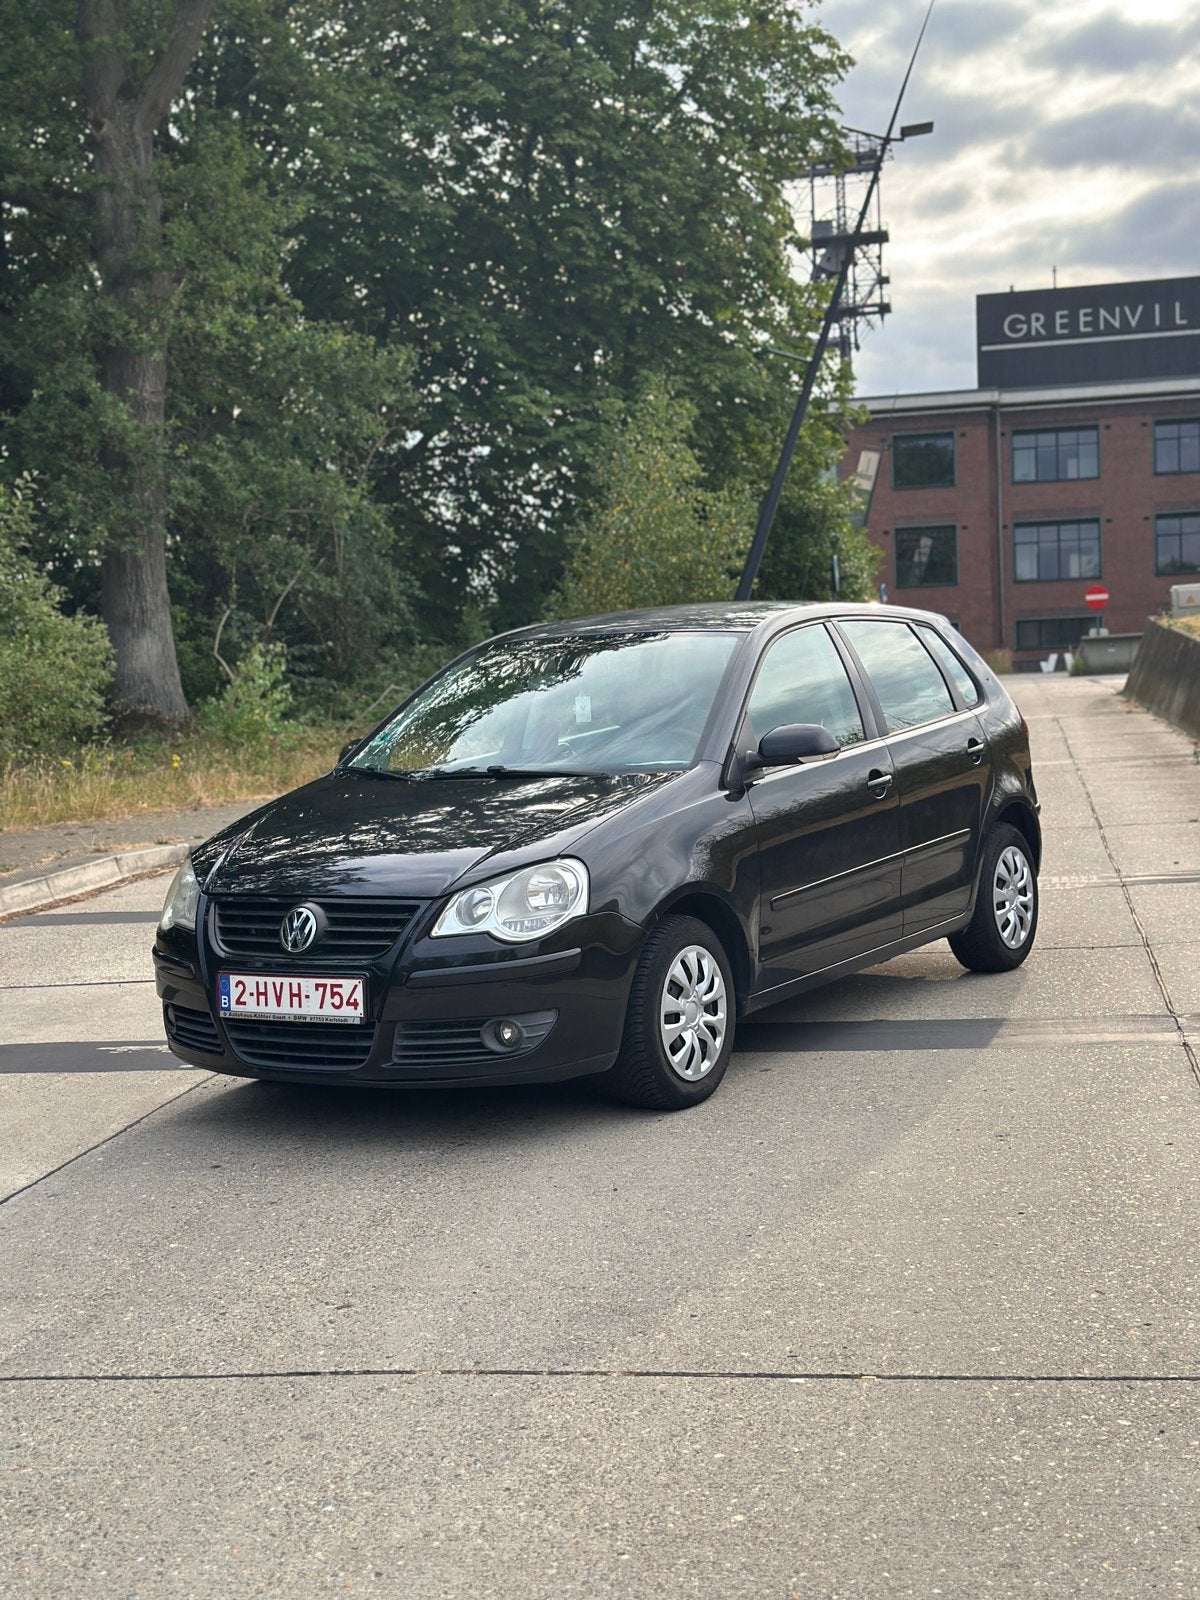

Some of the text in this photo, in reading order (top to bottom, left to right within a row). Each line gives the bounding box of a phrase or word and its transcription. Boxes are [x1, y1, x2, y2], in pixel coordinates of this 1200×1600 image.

[1003, 301, 1188, 338] GREENVIL
[221, 996, 229, 1008] B
[234, 979, 360, 1010] 2-HVH-754
